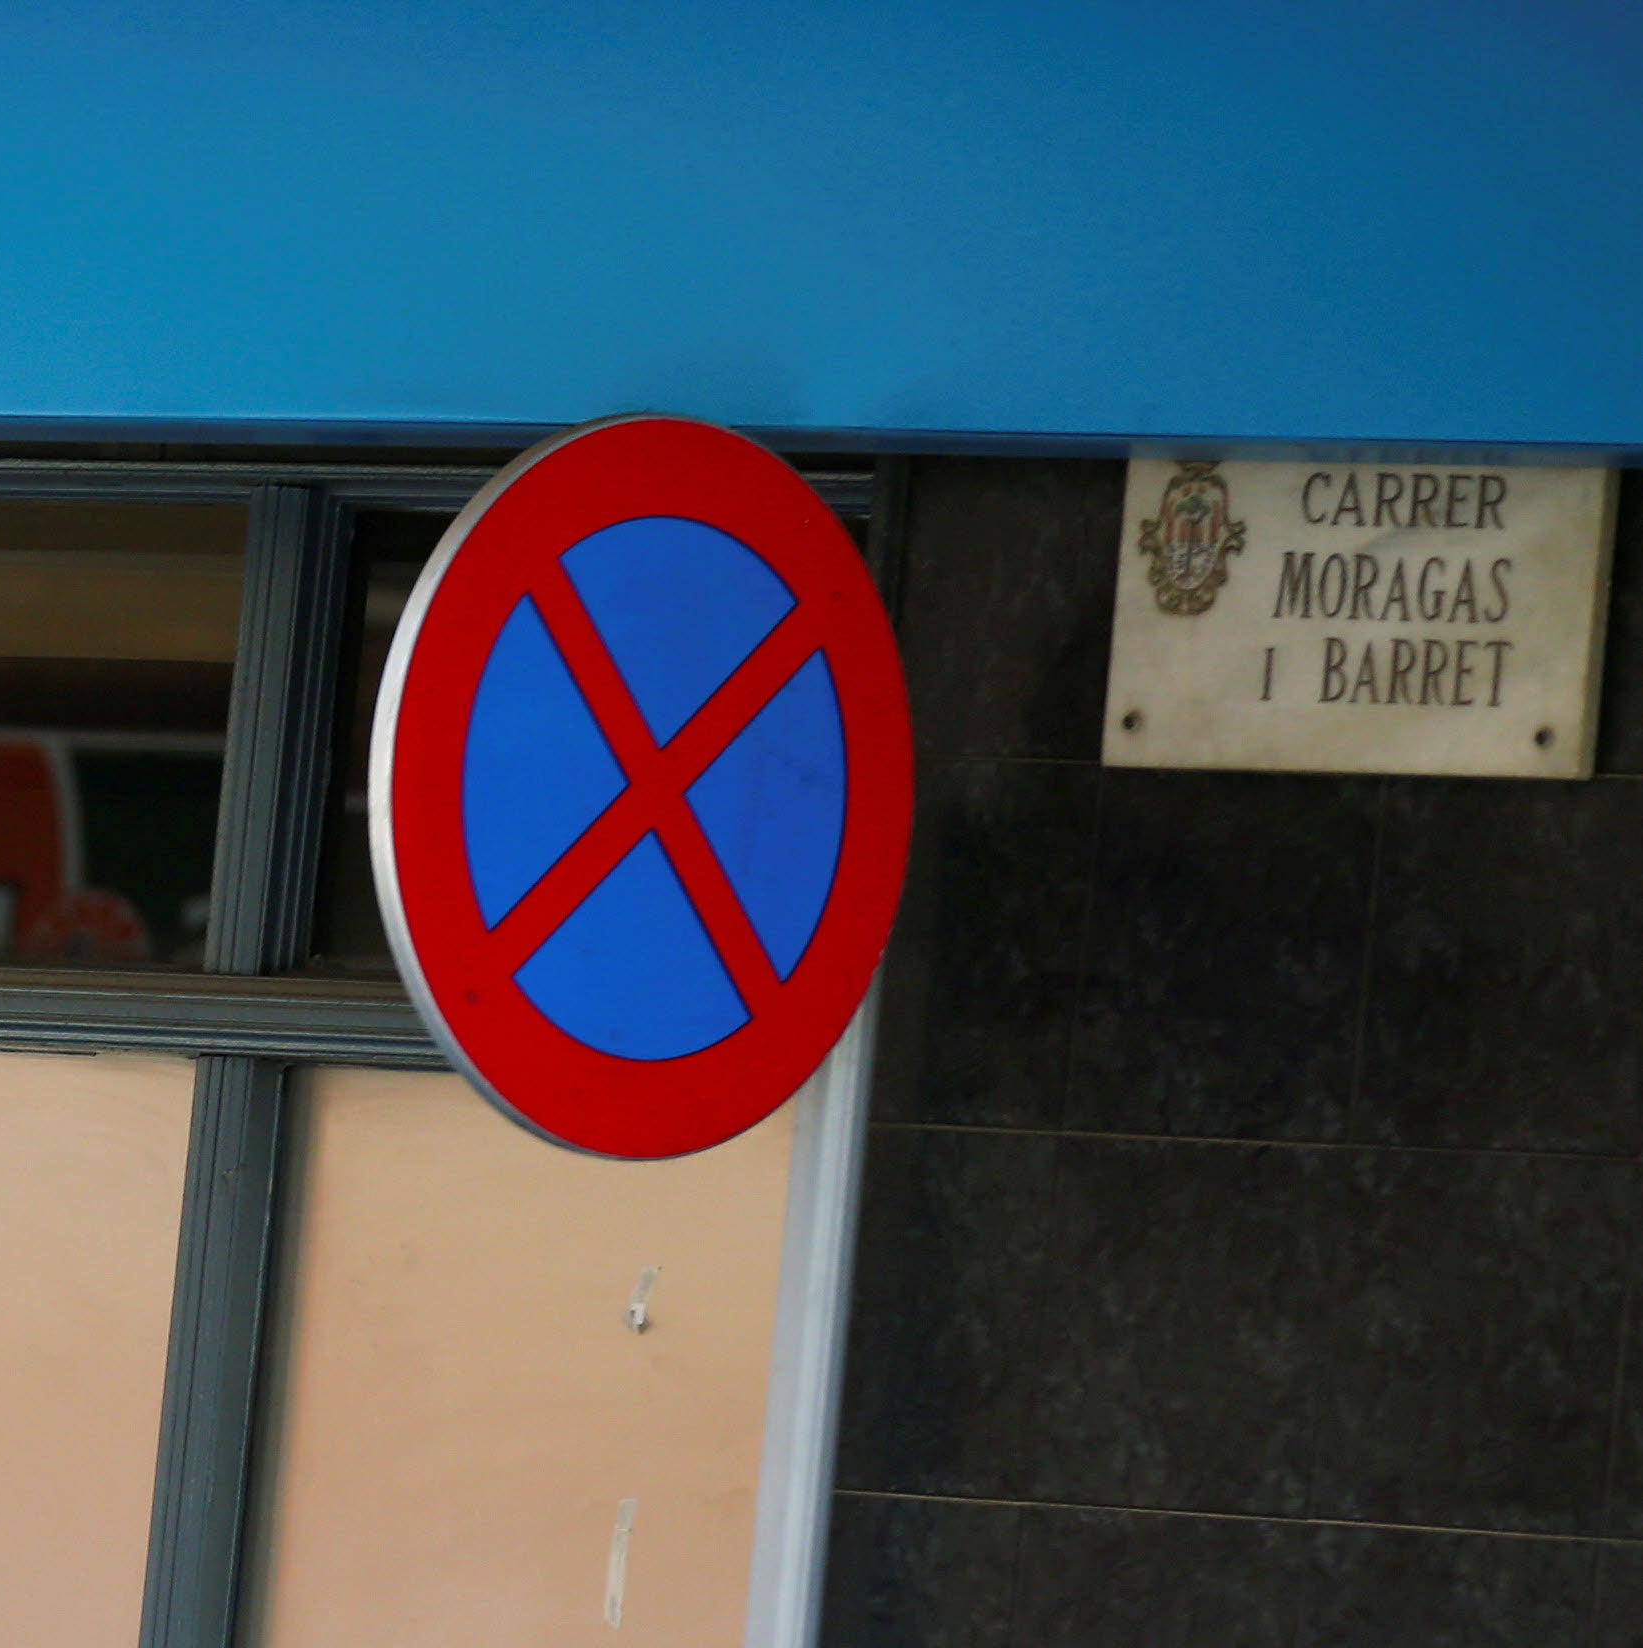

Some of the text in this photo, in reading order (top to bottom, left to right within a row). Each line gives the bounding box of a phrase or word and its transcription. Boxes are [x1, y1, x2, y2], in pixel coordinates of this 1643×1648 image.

[1300, 470, 1508, 530] CARRER
[1271, 551, 1513, 624] MORAGAS
[1257, 636, 1514, 708] I BARRET
